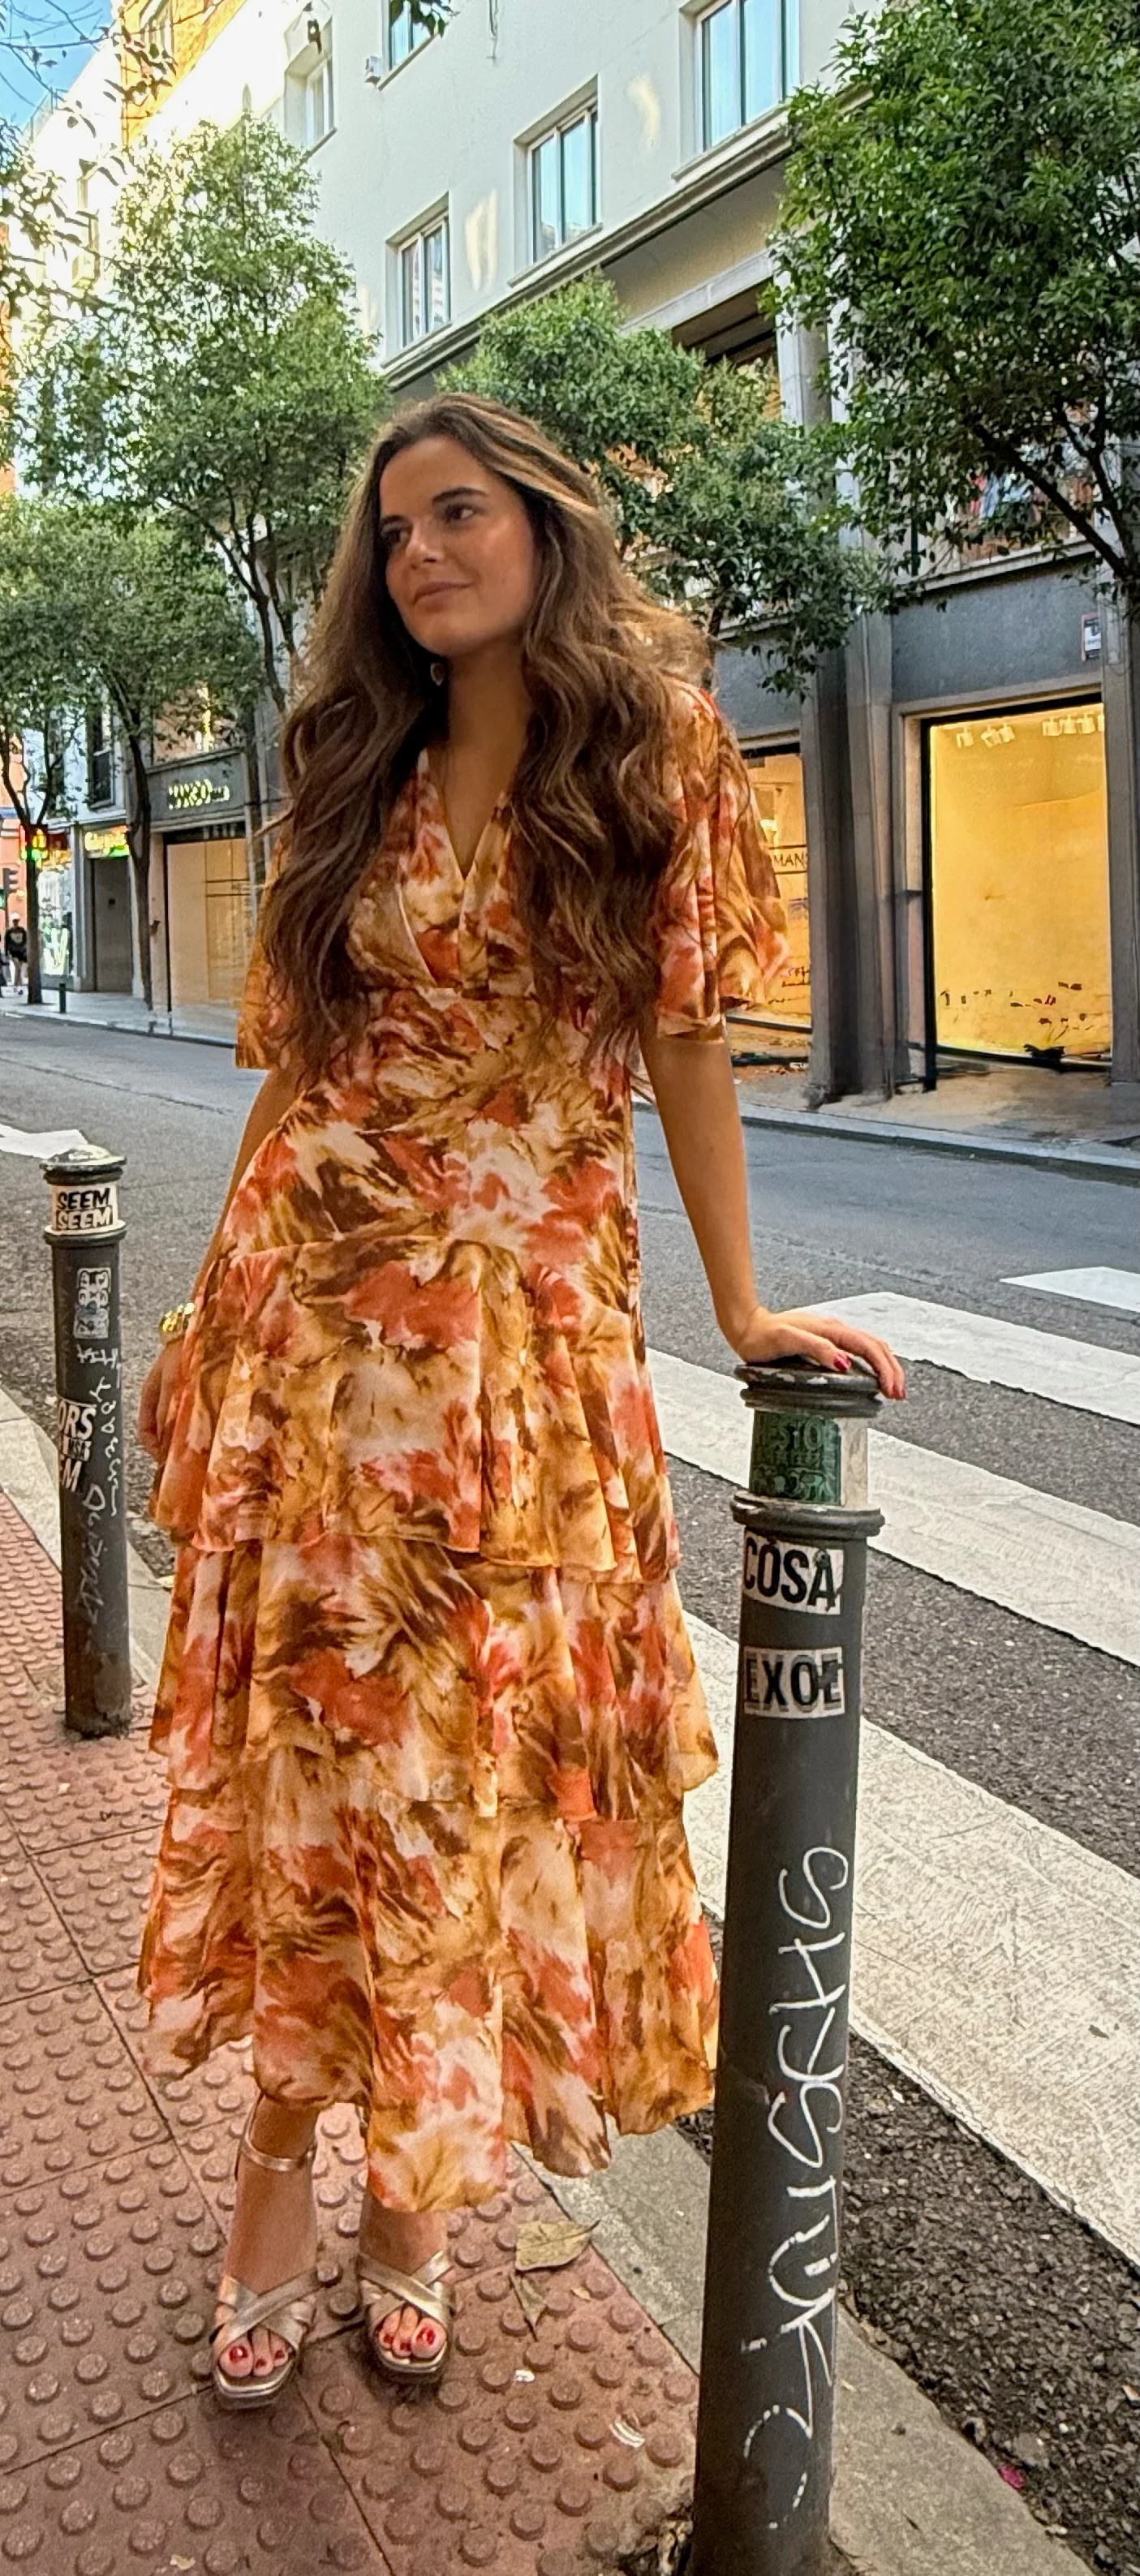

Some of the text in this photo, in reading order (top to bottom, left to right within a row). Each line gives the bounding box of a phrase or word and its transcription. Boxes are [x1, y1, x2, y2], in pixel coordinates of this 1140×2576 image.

[773, 852, 807, 869] MAN
[57, 1188, 110, 1210] SEEM
[57, 1206, 112, 1229] SEEM
[744, 1537, 837, 1610] COSA
